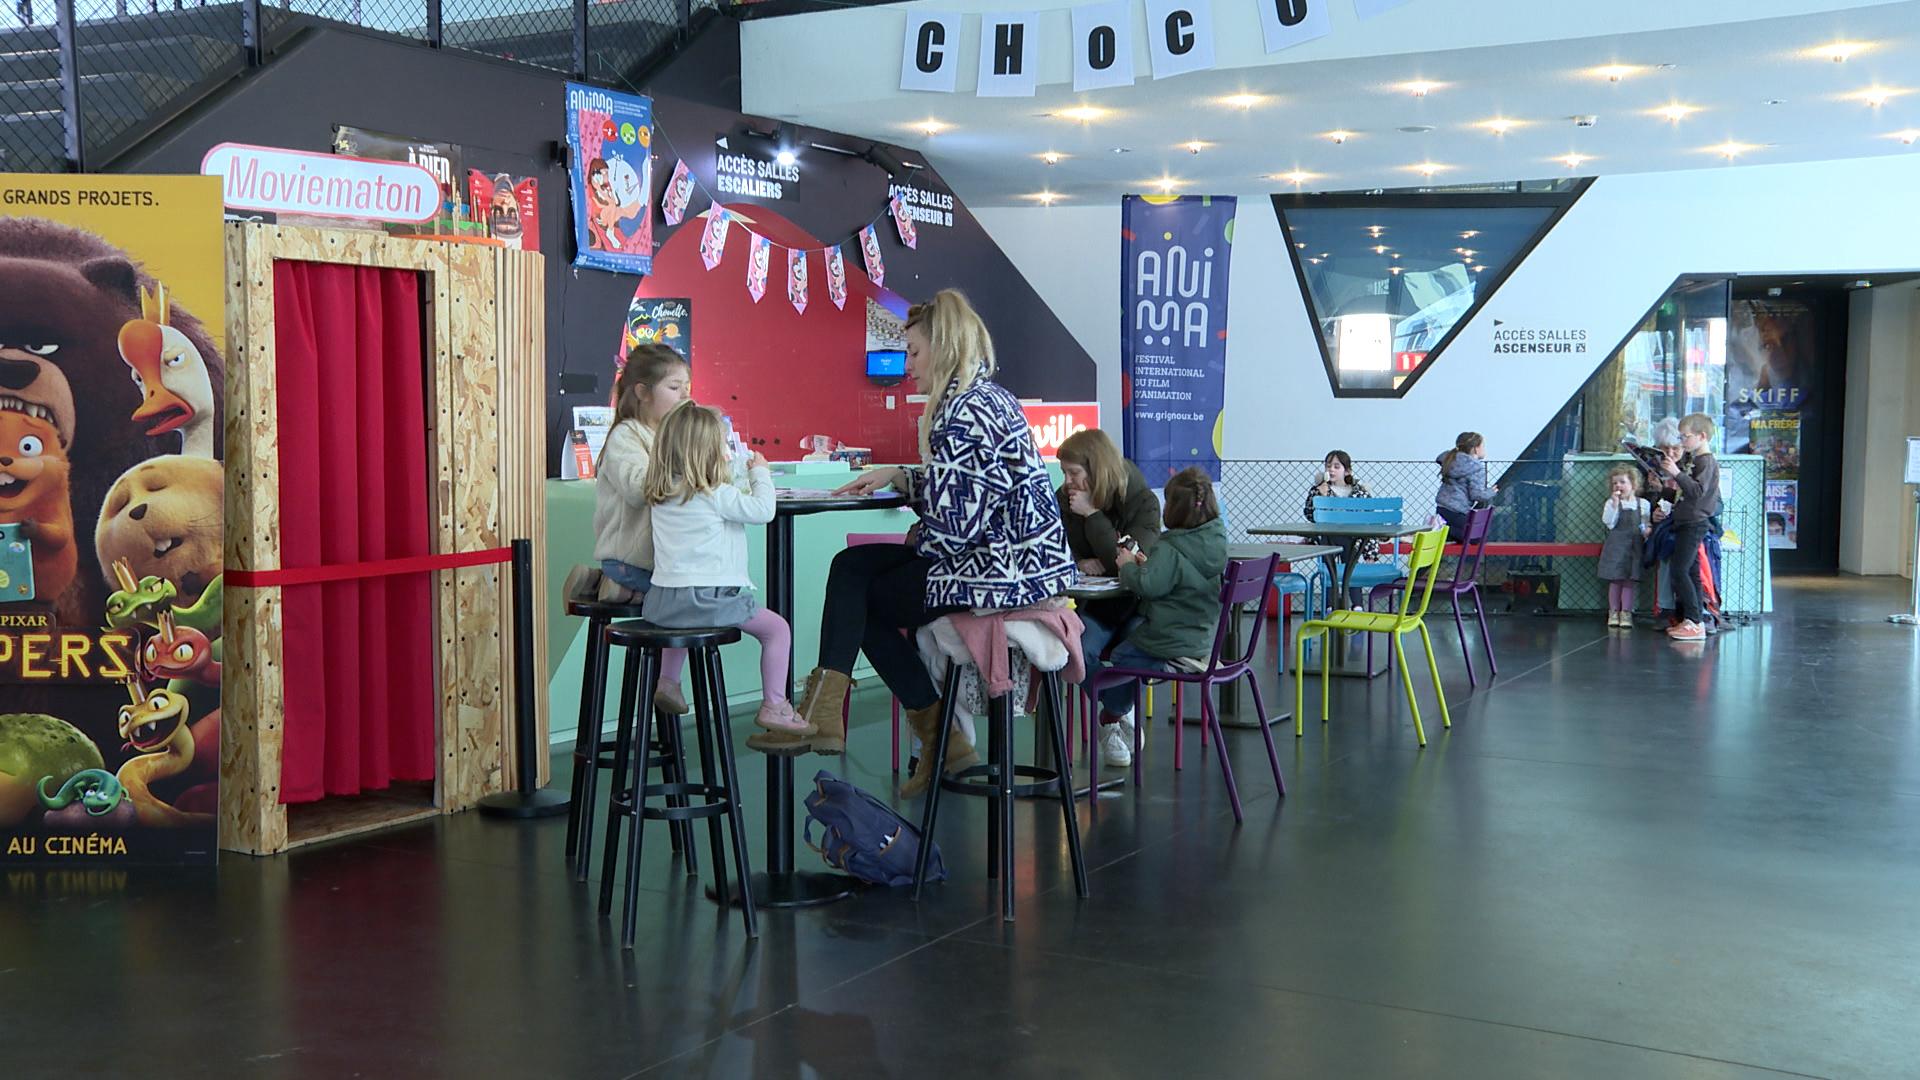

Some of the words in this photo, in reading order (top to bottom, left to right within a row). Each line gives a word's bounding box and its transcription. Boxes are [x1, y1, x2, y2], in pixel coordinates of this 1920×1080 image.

[717, 153, 756, 177] ACCÈS
[757, 160, 800, 183] SALLES
[226, 155, 422, 214] Moviematon
[717, 174, 783, 200] ESCALIERS
[3, 189, 71, 206] GRANDS
[77, 190, 160, 207] PROJETS.
[919, 189, 953, 210] SALLES
[1494, 327, 1535, 341] ACCÈS
[1539, 329, 1587, 341] SALLES
[1494, 343, 1572, 354] ASCENSEUR
[1135, 354, 1176, 365] FESTIVAL
[1135, 366, 1205, 378] INTERNATIONAL
[1148, 379, 1170, 388] FILM
[1739, 387, 1800, 403] SKIFF
[0, 615, 48, 627] PIXAR
[7, 837, 36, 855] AU
[44, 833, 128, 855] CINÉMA
